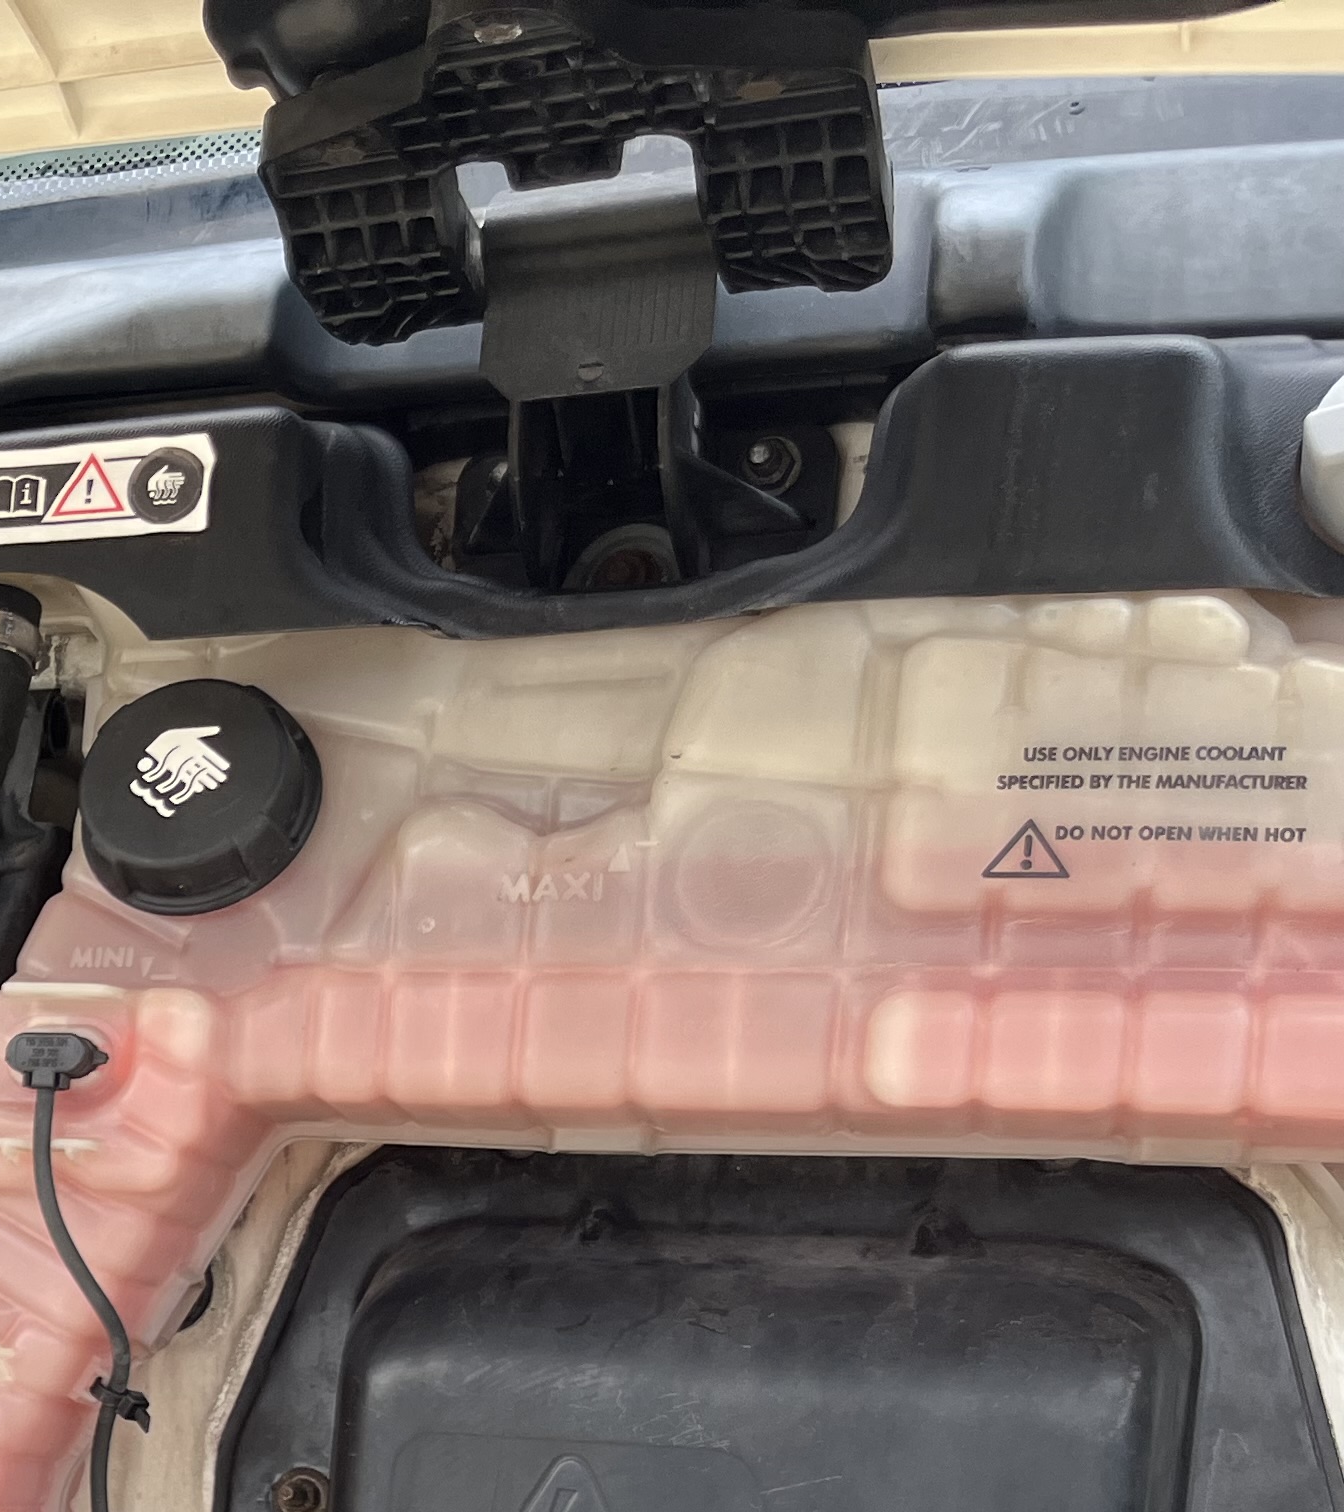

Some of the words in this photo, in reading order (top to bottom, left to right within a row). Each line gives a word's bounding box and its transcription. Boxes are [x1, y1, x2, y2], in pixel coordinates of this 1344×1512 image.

[1023, 746, 1057, 762] USE
[1062, 746, 1114, 762] ONLY
[1118, 746, 1190, 762] ENGINE
[1195, 746, 1287, 762] COOLANT
[996, 774, 1084, 790] SPECIFIED
[1089, 774, 1114, 790] BY
[1118, 774, 1151, 790] THE
[1155, 774, 1308, 791] MANUFACTURER
[1055, 825, 1085, 841] DO
[1091, 825, 1133, 842] NOT
[1138, 826, 1193, 842] OPEN
[1198, 827, 1259, 843] WHEN
[1264, 827, 1307, 843] HOT
[499, 872, 605, 902] MAXI
[69, 946, 134, 969] MINI
